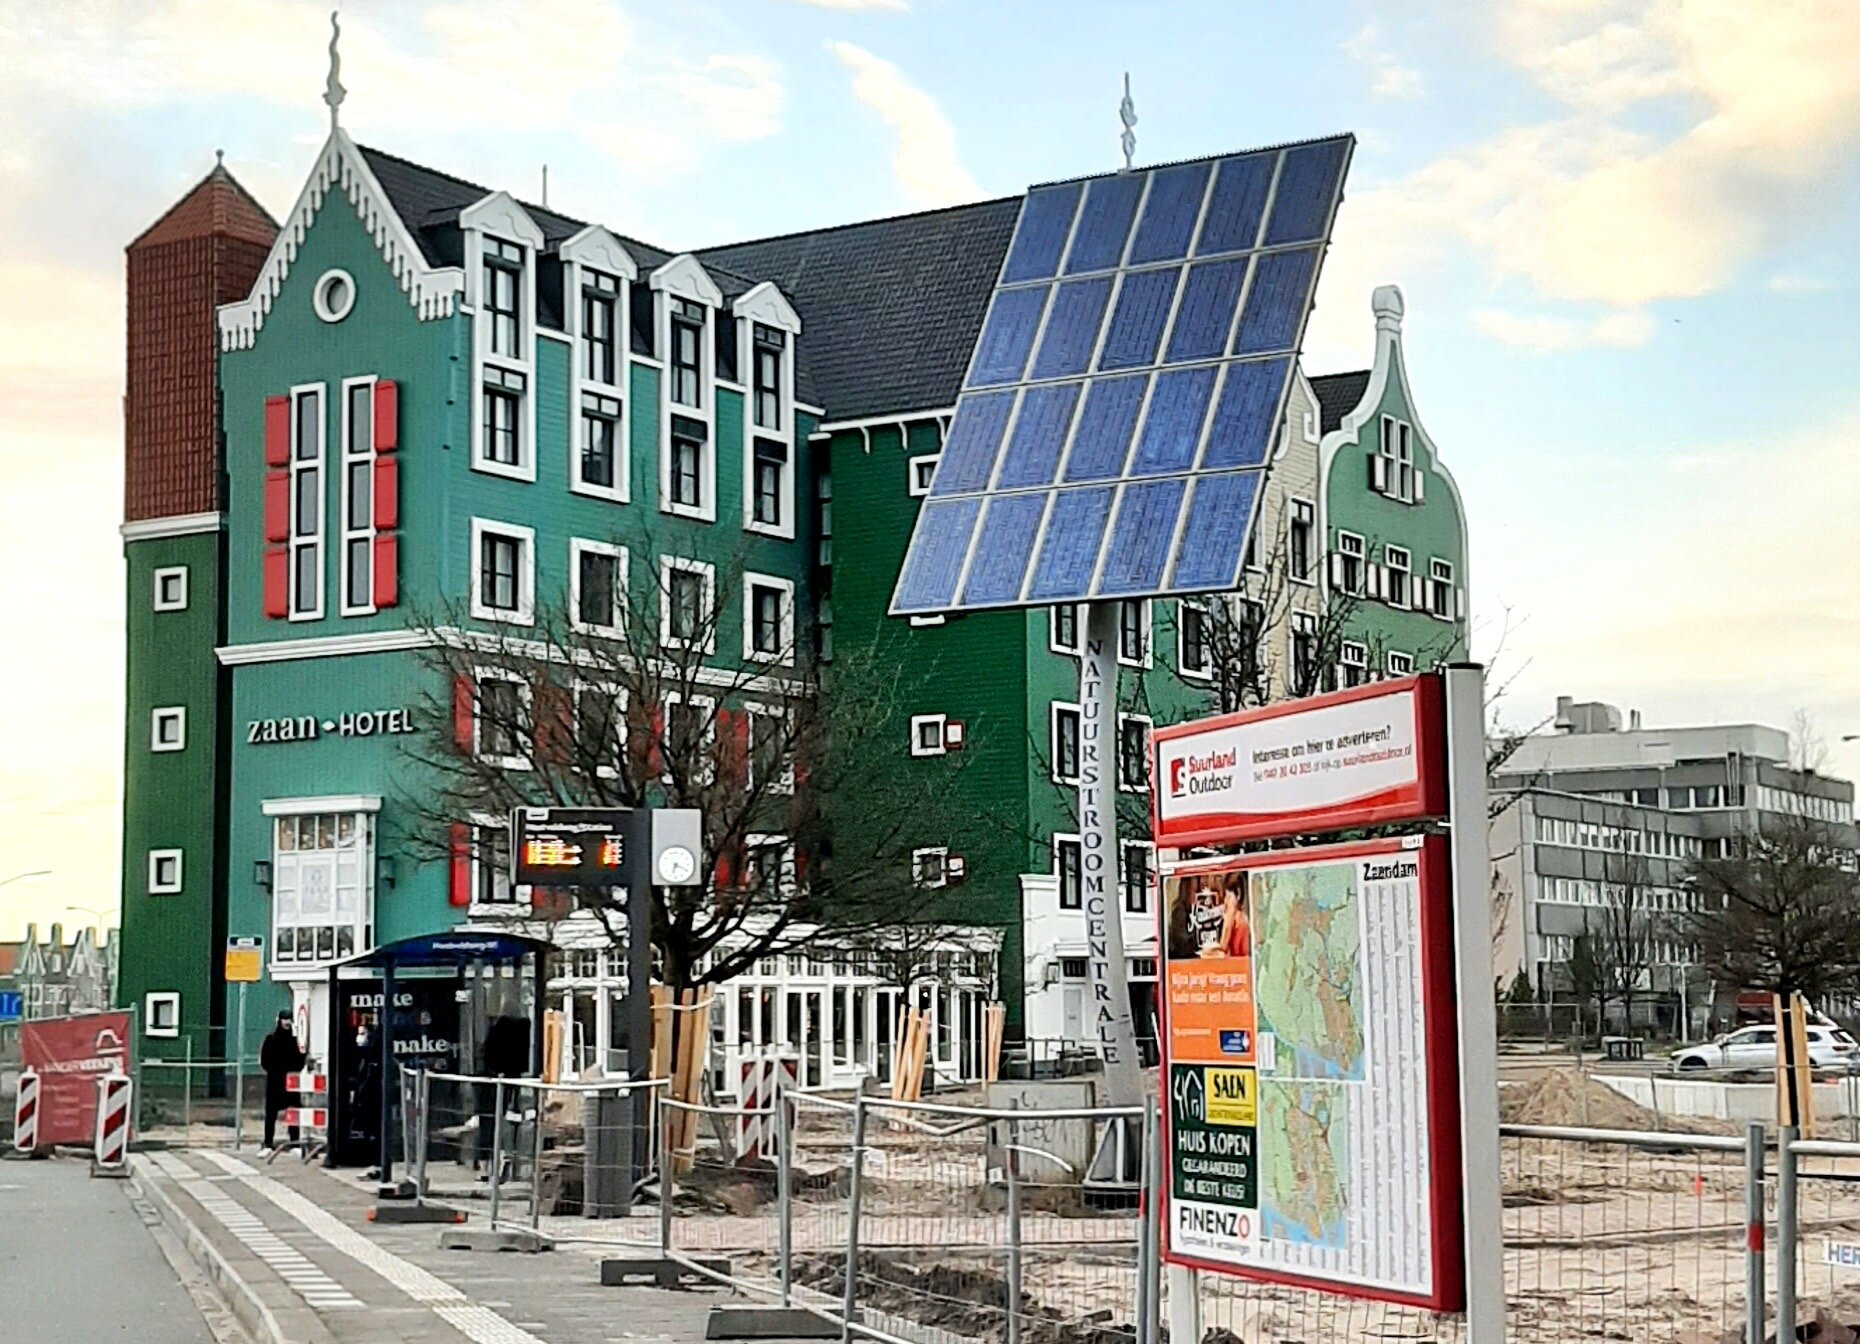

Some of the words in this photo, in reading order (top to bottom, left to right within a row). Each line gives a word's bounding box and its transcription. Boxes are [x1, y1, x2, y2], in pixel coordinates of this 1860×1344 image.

[246, 715, 317, 744] zaan
[339, 709, 414, 736] HOTEL
[1188, 747, 1237, 774] Suurland
[1189, 773, 1234, 795] Outdoor
[1082, 639, 1120, 1064] NATUURSTROOMCENTRALE
[1177, 1129, 1206, 1154] HUIS
[1209, 1131, 1251, 1157] KOPEN
[1179, 1206, 1251, 1239] FINENZO
